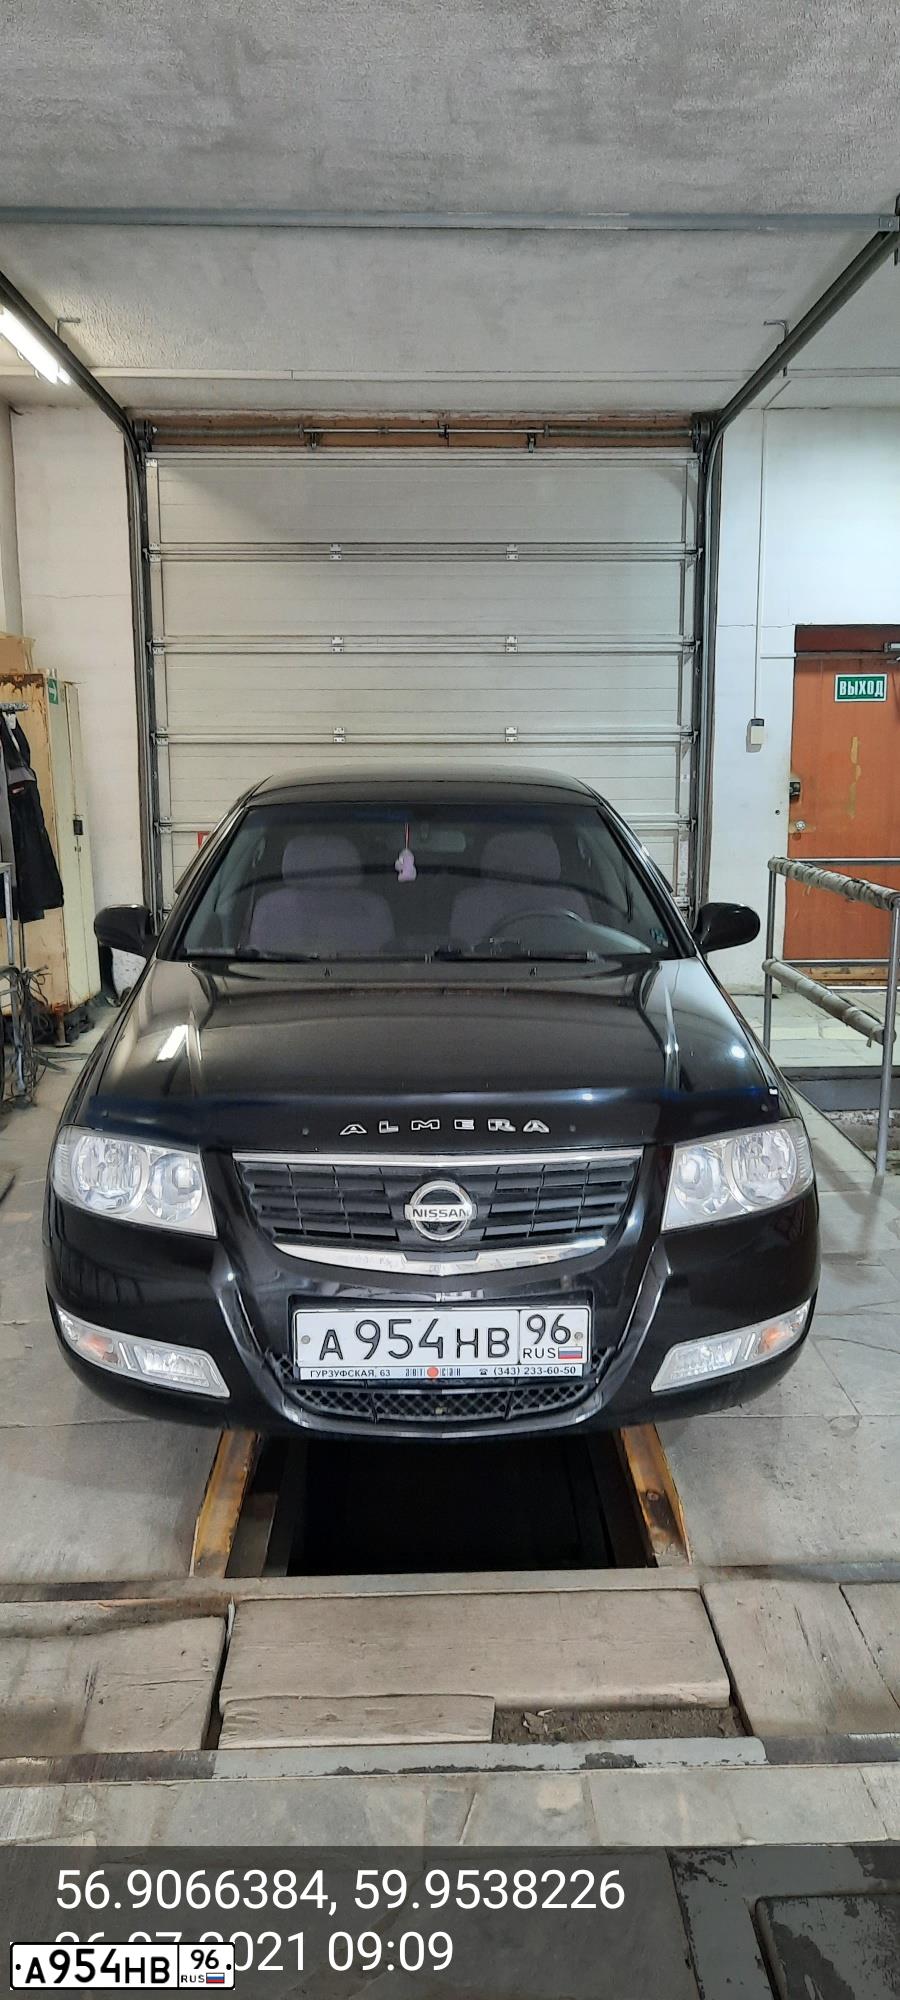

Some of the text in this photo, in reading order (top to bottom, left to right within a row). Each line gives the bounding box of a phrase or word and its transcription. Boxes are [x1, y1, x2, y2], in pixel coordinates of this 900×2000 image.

[839, 680, 884, 698] ВЫХОД
[339, 1118, 550, 1136] ALMERA
[412, 1207, 470, 1218] NISSAN
[526, 1313, 572, 1345] 96
[522, 1346, 557, 1359] RUS
[379, 1369, 391, 1377] 63
[493, 1367, 520, 1376] (343)
[523, 1366, 576, 1375] 233-60-50
